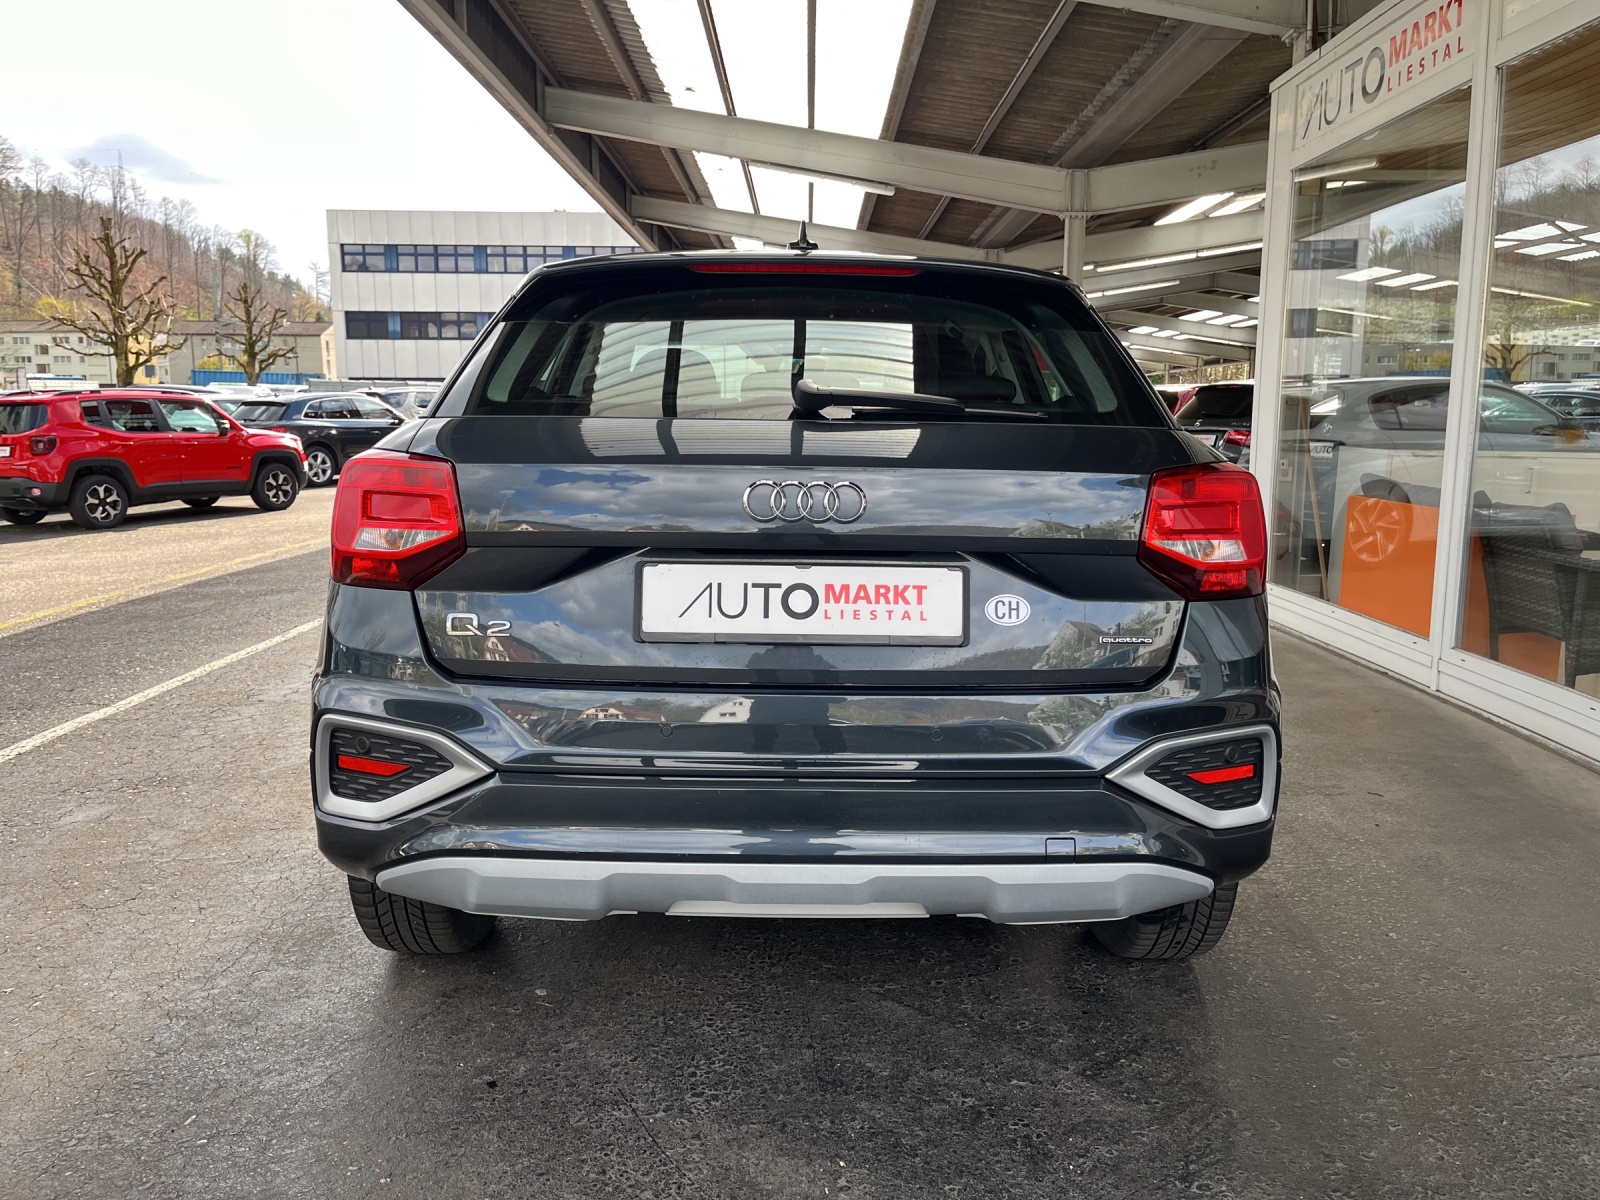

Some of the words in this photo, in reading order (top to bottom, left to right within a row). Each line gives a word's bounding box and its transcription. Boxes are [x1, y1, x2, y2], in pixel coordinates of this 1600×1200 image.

[1302, 46, 1386, 140] AUTO
[1388, 0, 1464, 69] MARKT
[1387, 36, 1464, 93] LIESTAL
[678, 582, 820, 620] AUTO
[824, 583, 928, 606] MARKT
[824, 608, 928, 622] LIESTAL
[994, 599, 1020, 620] CH
